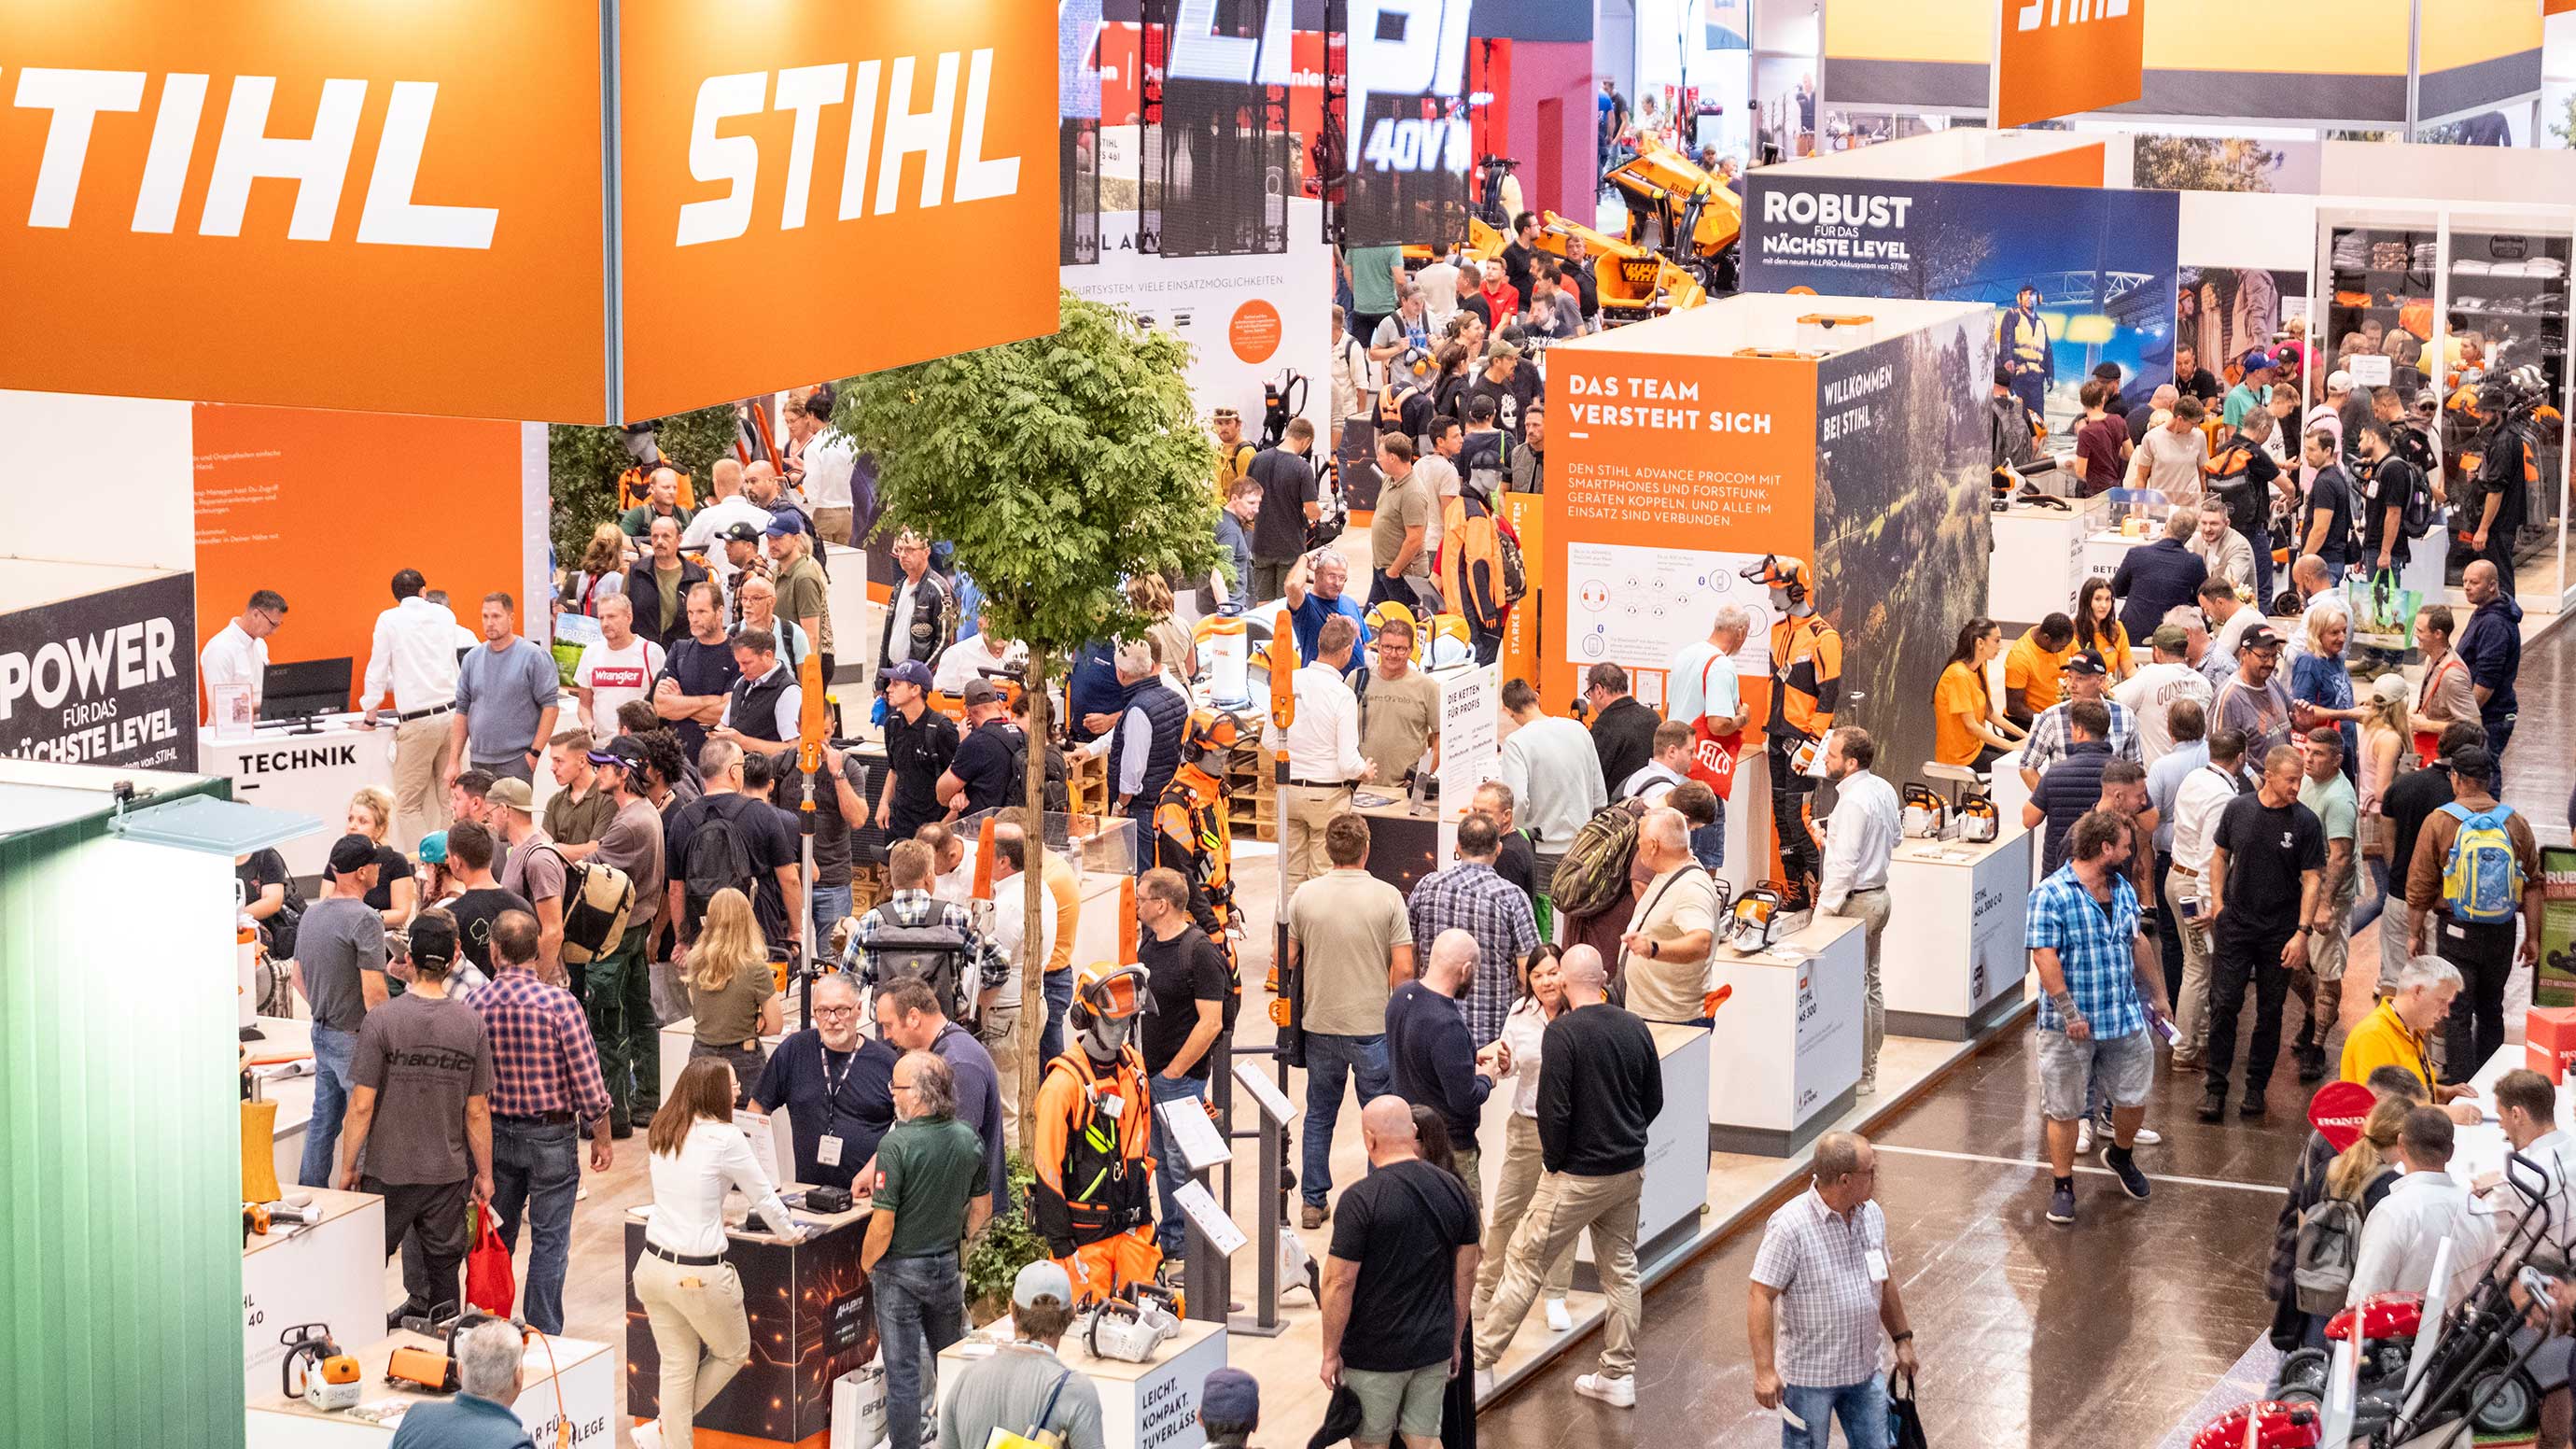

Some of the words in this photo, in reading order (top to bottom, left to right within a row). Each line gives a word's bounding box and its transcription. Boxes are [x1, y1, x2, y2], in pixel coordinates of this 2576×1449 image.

[0, 66, 499, 249] TIHL
[675, 48, 1021, 246] STIHL
[1764, 190, 1912, 229] ROBUST
[1763, 232, 1849, 257] NÄCHSTE
[1853, 240, 1911, 260] LEVEL
[1814, 224, 1836, 237] FÜR
[1838, 226, 1859, 238] DAS
[1889, 262, 1909, 271] STIHL
[1139, 282, 1165, 292] VIELE
[1570, 374, 1619, 396] DAS
[1628, 377, 1699, 401] TEAM
[1825, 364, 1892, 407] WILLKOMMEN
[1569, 403, 1701, 430] VERSTEHT
[1709, 411, 1771, 434] SICH
[1824, 415, 1841, 442] BEI
[1842, 404, 1871, 435] STIHL
[1568, 463, 1594, 474] DEN
[1597, 465, 1631, 477] STIHL
[1635, 467, 1694, 481] ADVANCE
[1698, 471, 1756, 485] PROCOM
[1759, 474, 1782, 485] MIT
[1568, 477, 1659, 493] SMARTPHONES
[1663, 483, 1690, 495] UND
[1693, 485, 1770, 499] FORSTFUNK-
[1567, 491, 1624, 505] GERÄTEN
[1692, 499, 1718, 511] UND
[1722, 501, 1753, 513] ALLE
[1757, 504, 1771, 513] IM
[1568, 506, 1617, 520] EINSATZ
[1621, 510, 1651, 522] SIND
[1654, 513, 1733, 527] VERBUNDEN.
[1511, 613, 1520, 654] STARKE
[0, 616, 177, 721] POWER
[595, 670, 639, 685] Wrangler
[63, 703, 90, 729] FÜR
[91, 697, 117, 723] DAS
[110, 708, 177, 753] LEVEL
[155, 747, 177, 764] STIHL
[239, 744, 357, 775] TECHNIK
[1696, 739, 1734, 775] FELCO
[2317, 1117, 2365, 1127] HOND
[1142, 1376, 1178, 1410] LEICHT.
[1142, 1392, 1189, 1432] KOMPAKT.
[1142, 1409, 1196, 1449] ZUVERLÄSS
